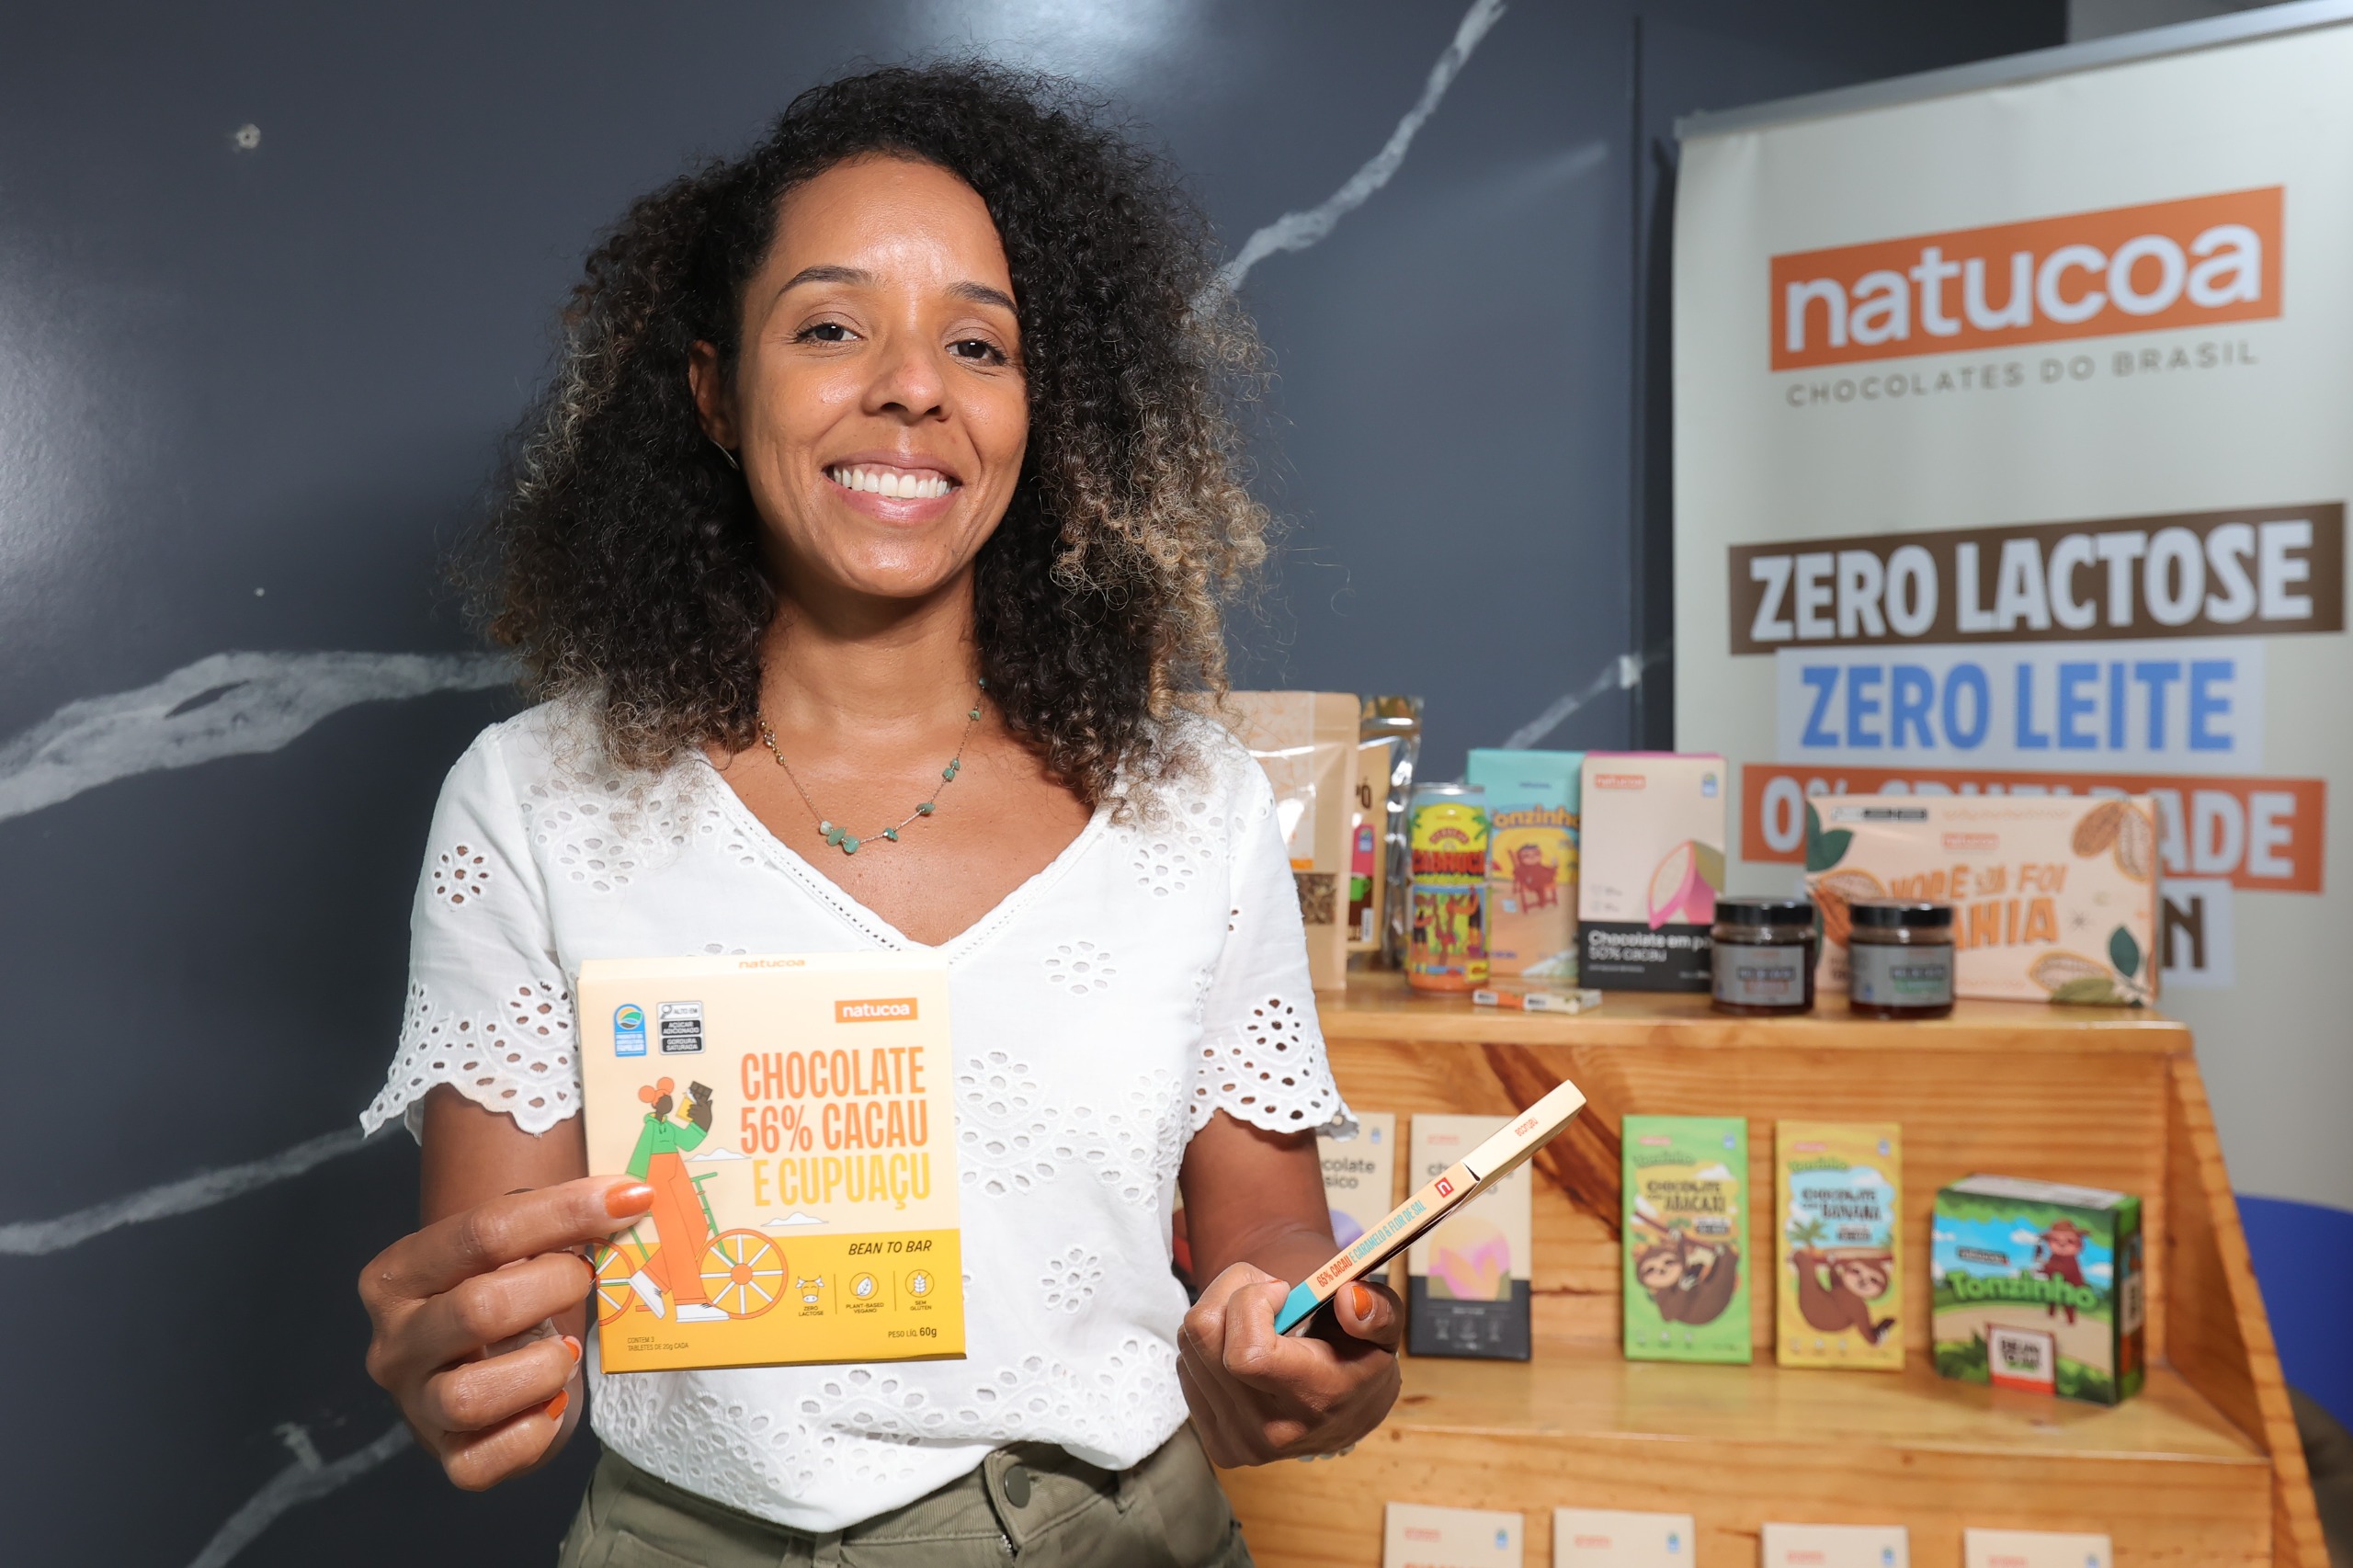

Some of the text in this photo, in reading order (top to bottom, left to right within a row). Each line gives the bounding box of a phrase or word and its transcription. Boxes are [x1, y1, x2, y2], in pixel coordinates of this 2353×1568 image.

[1785, 223, 2262, 353] natucoa
[1785, 339, 2260, 408] CHOCOLATES DO BRASIL
[1749, 519, 2313, 642] ZERO LACTOSE
[1800, 659, 2235, 752] ZERO LEITE
[1587, 929, 1666, 948] Chocolate
[738, 959, 806, 969] natucoa
[842, 1003, 911, 1017] natucoa
[741, 1046, 926, 1101] CHOCOLATE
[741, 1099, 928, 1153] 56% CACAU
[752, 1153, 931, 1210] E CUPUAÇU
[1322, 1157, 1375, 1174] colate
[1324, 1174, 1358, 1189] sico
[848, 1240, 933, 1256] BEAN TO BAR
[1316, 1269, 1335, 1288] 65%
[1332, 1255, 1353, 1278] CACAU
[1348, 1252, 1357, 1264] E
[1353, 1229, 1388, 1260] CARAMELO
[1387, 1213, 1405, 1233] FLOR
[1402, 1207, 1415, 1222] DE
[1412, 1199, 1427, 1216] SAL
[1945, 1269, 2097, 1310] Tonzinho
[627, 1344, 654, 1352] TABLETES
[663, 1343, 674, 1351] 20g
[888, 1330, 904, 1338] PESO
[919, 1326, 938, 1338] 60g
